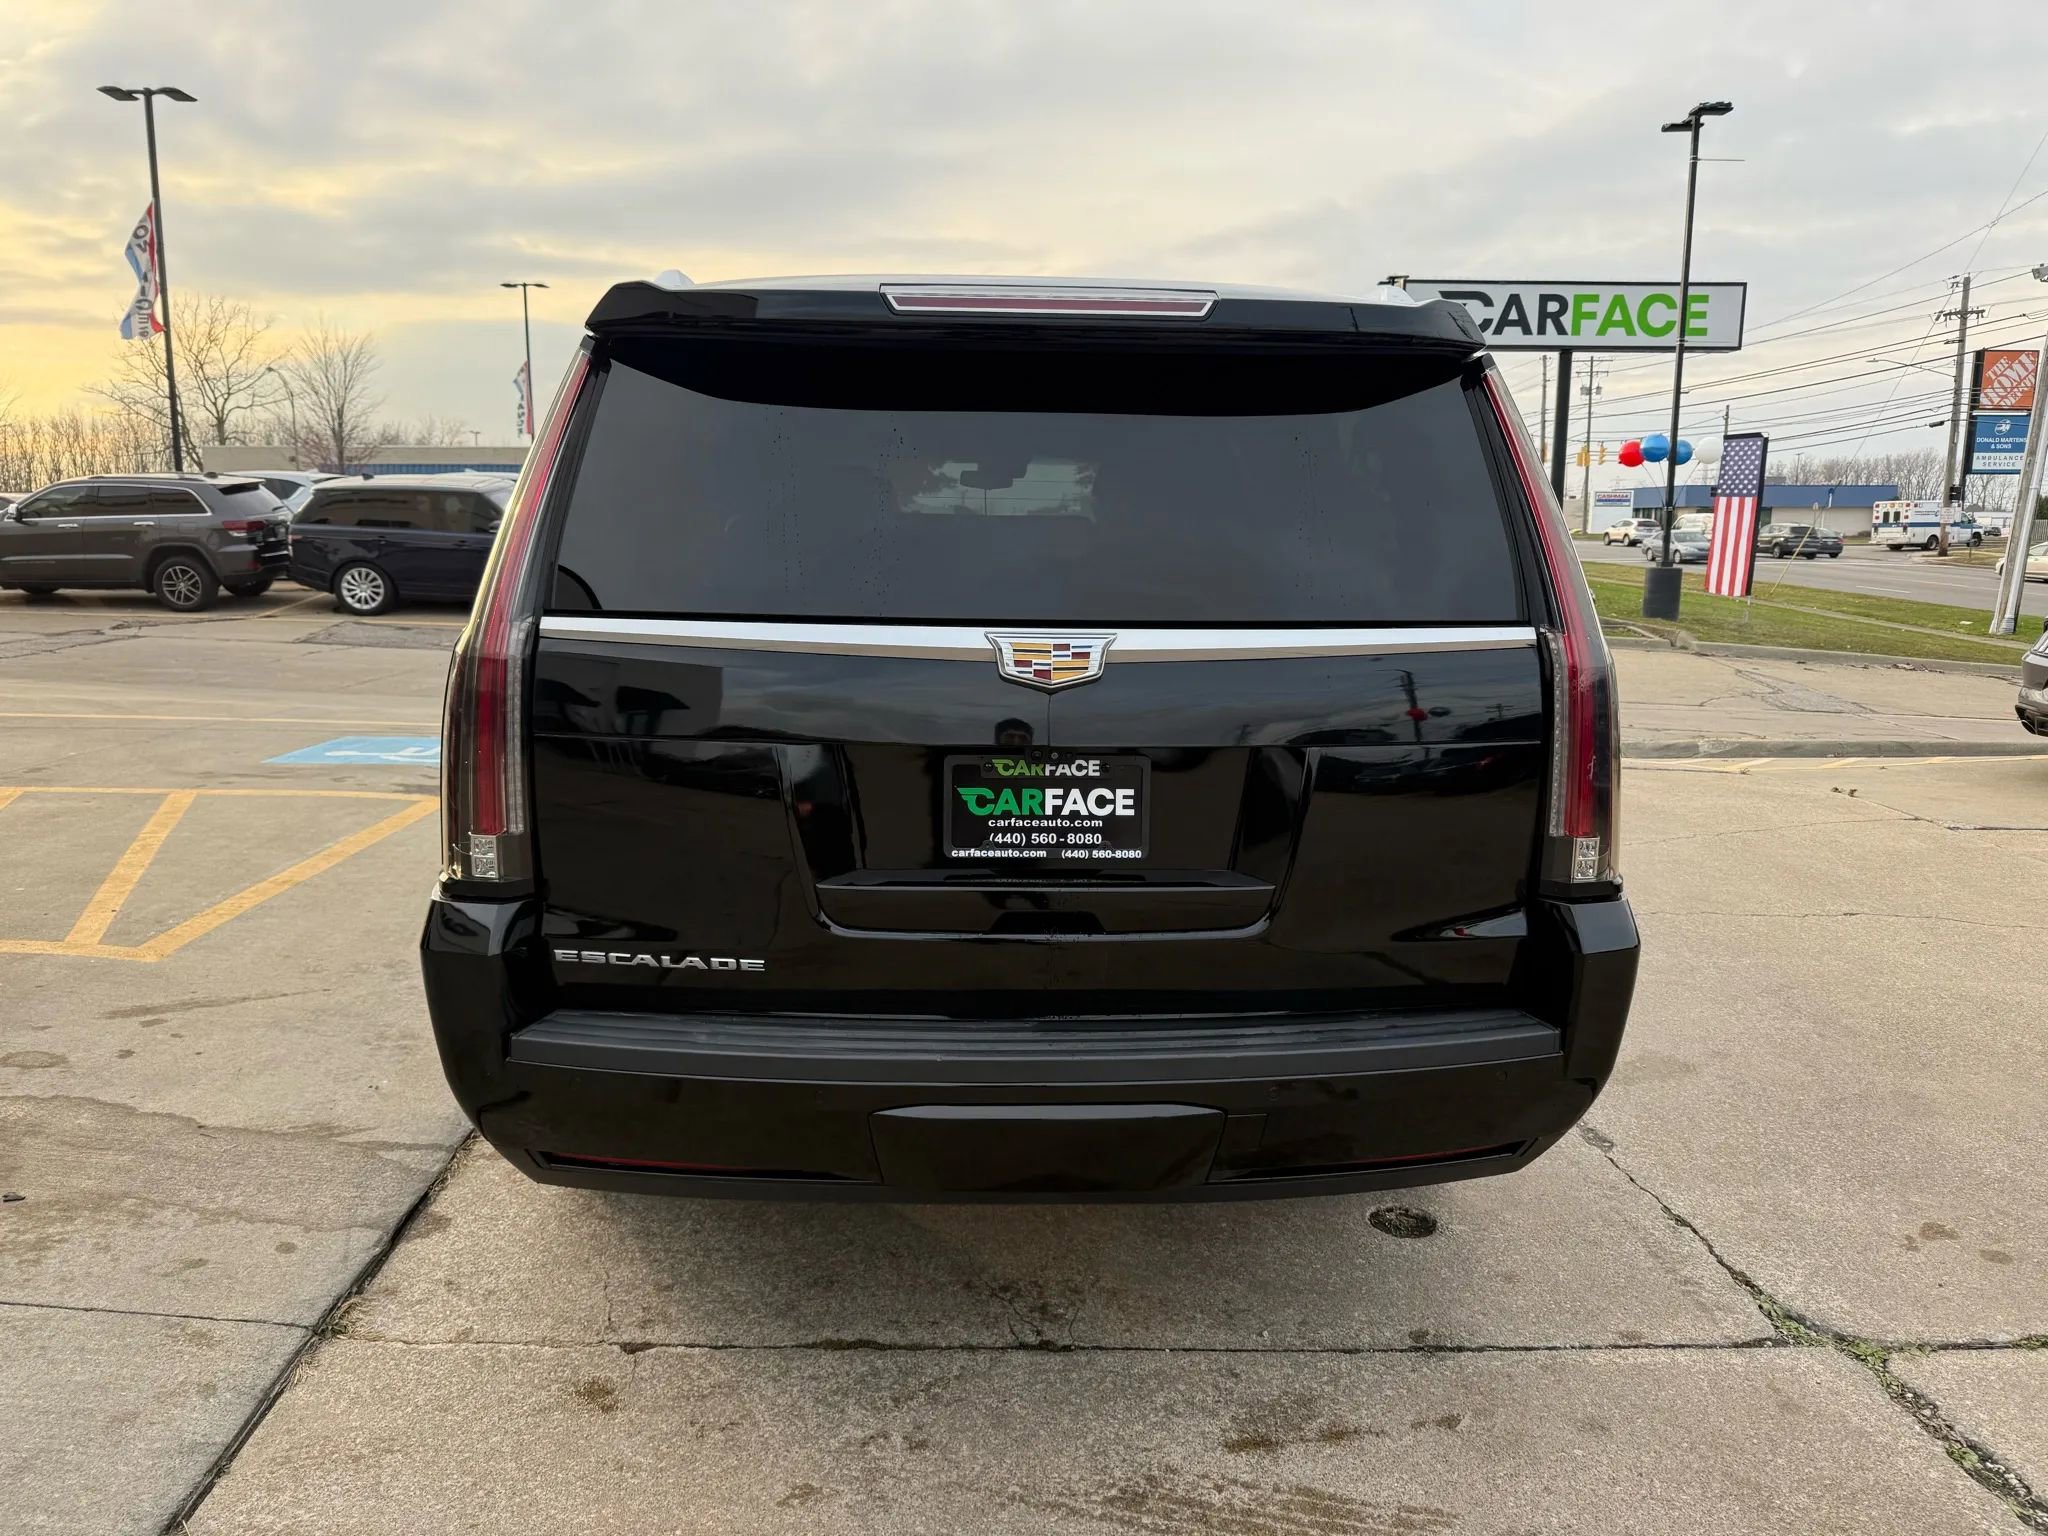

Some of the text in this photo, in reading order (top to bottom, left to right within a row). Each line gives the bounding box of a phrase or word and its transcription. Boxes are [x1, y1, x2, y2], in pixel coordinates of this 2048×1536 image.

[1438, 290, 1711, 338] CARFACE
[1985, 355, 2009, 381] THE
[992, 759, 1100, 776] CARFACE
[954, 785, 1135, 816] CARFACE
[988, 817, 1103, 828] carfaceauto.com
[990, 832, 1026, 846] (440)
[952, 849, 1142, 859] carfaceauto.com (440) 560-8080
[553, 949, 766, 972] ESCALADE
